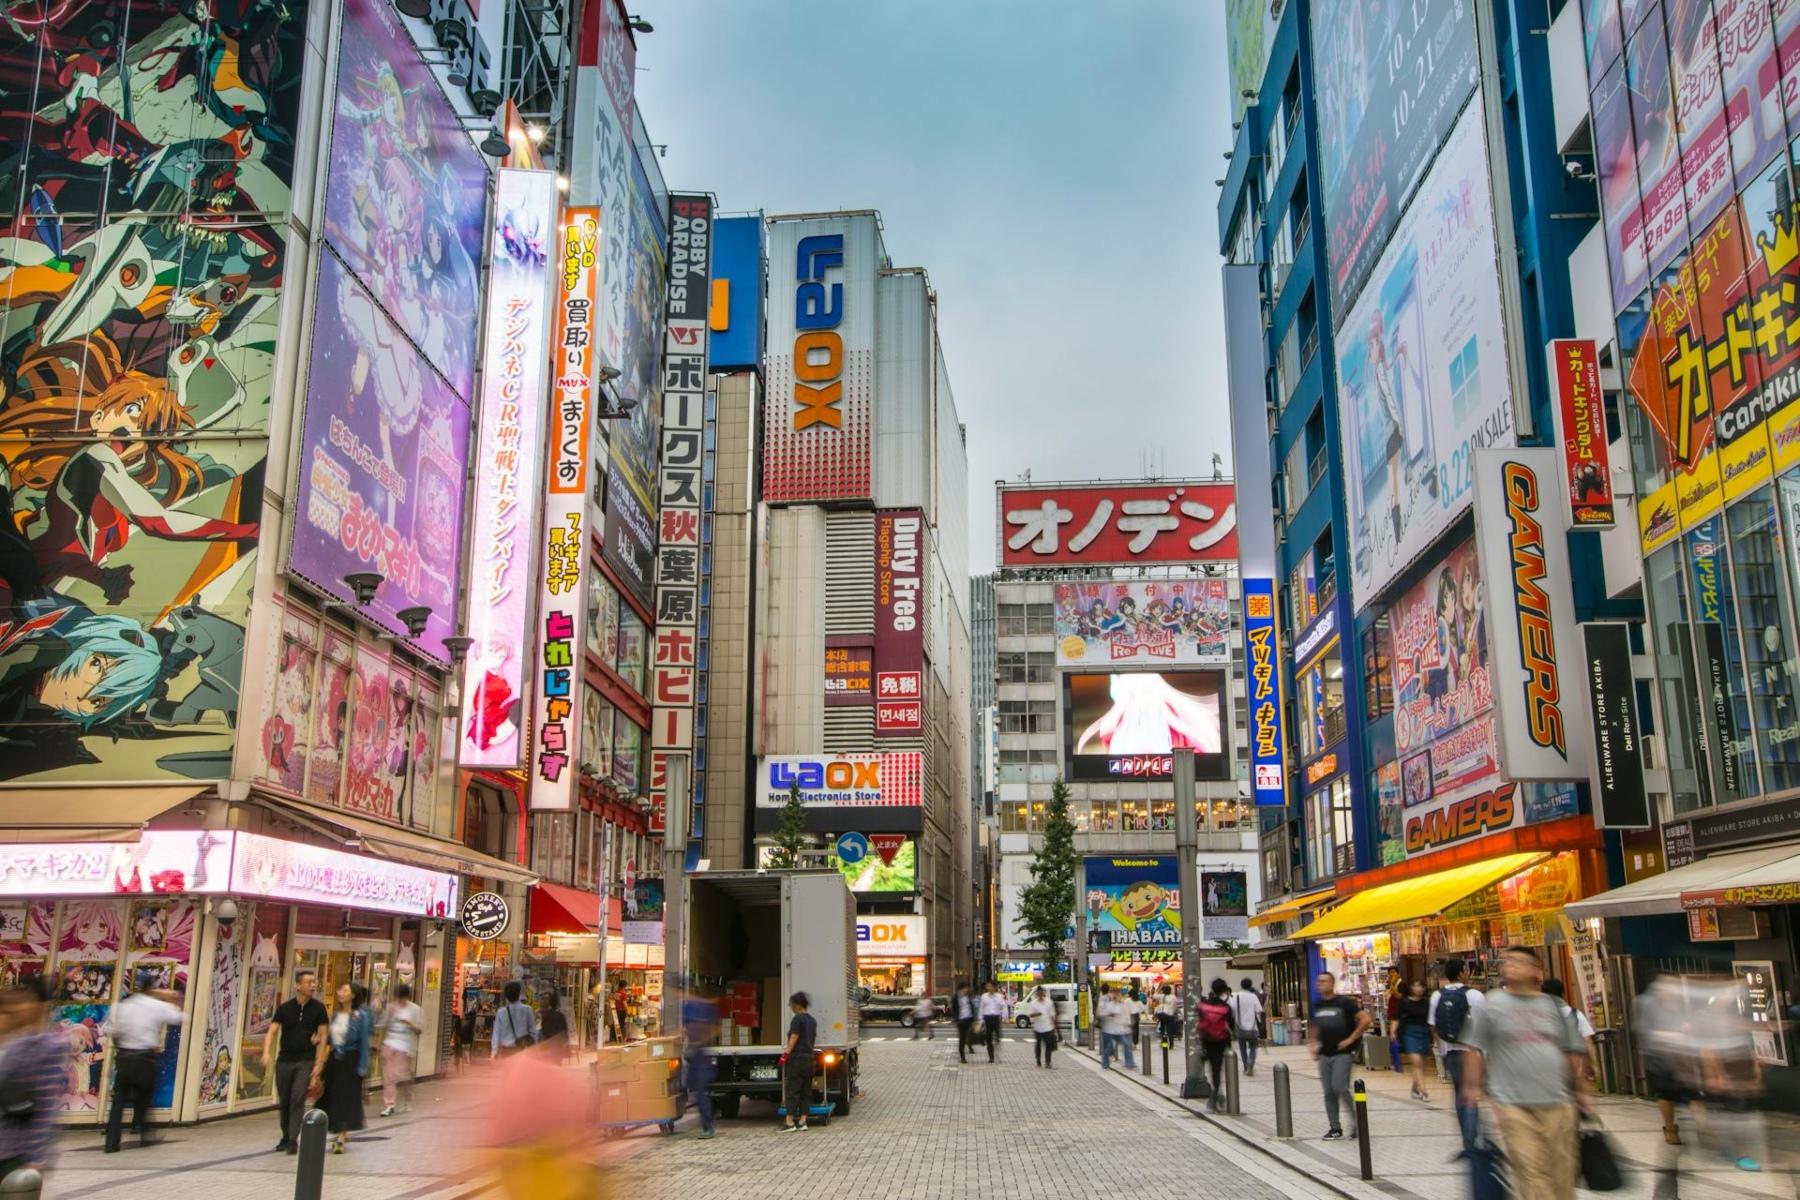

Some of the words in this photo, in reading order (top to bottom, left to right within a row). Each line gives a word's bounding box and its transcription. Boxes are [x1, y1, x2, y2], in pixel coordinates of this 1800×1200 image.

[581, 218, 597, 268] DVD
[688, 202, 708, 277] HOBBY
[566, 298, 591, 367] 買取り
[1486, 400, 1511, 448] SALE
[1568, 359, 1594, 460] カードキングダム
[558, 399, 584, 484] まっくす
[880, 517, 892, 567] Flagship
[892, 517, 920, 574] Duty
[1006, 487, 1236, 554] オノデン
[546, 527, 566, 596] 買います
[563, 512, 582, 593] フィギュア
[880, 571, 892, 606] Store
[892, 577, 920, 631] Free
[1249, 597, 1271, 616] 薬
[1500, 460, 1568, 762] GAMERS
[538, 610, 575, 784] とれじゃらす
[1593, 659, 1605, 690] AKIBA
[879, 708, 919, 722] 면세점
[1598, 693, 1609, 726] STORE
[1621, 697, 1629, 713] Site
[1623, 715, 1632, 733] Real
[1109, 755, 1173, 776] ANIPLE
[1601, 727, 1615, 790] ALIENWARE
[1625, 734, 1633, 751] Dell
[769, 792, 797, 802] Hom
[855, 790, 881, 800] Store
[1405, 783, 1517, 854] GAMERS
[1700, 822, 1737, 836] ALIENWARE
[1738, 818, 1761, 830] STORE
[1762, 815, 1785, 825] AKIBA
[1112, 859, 1148, 867] Welcome
